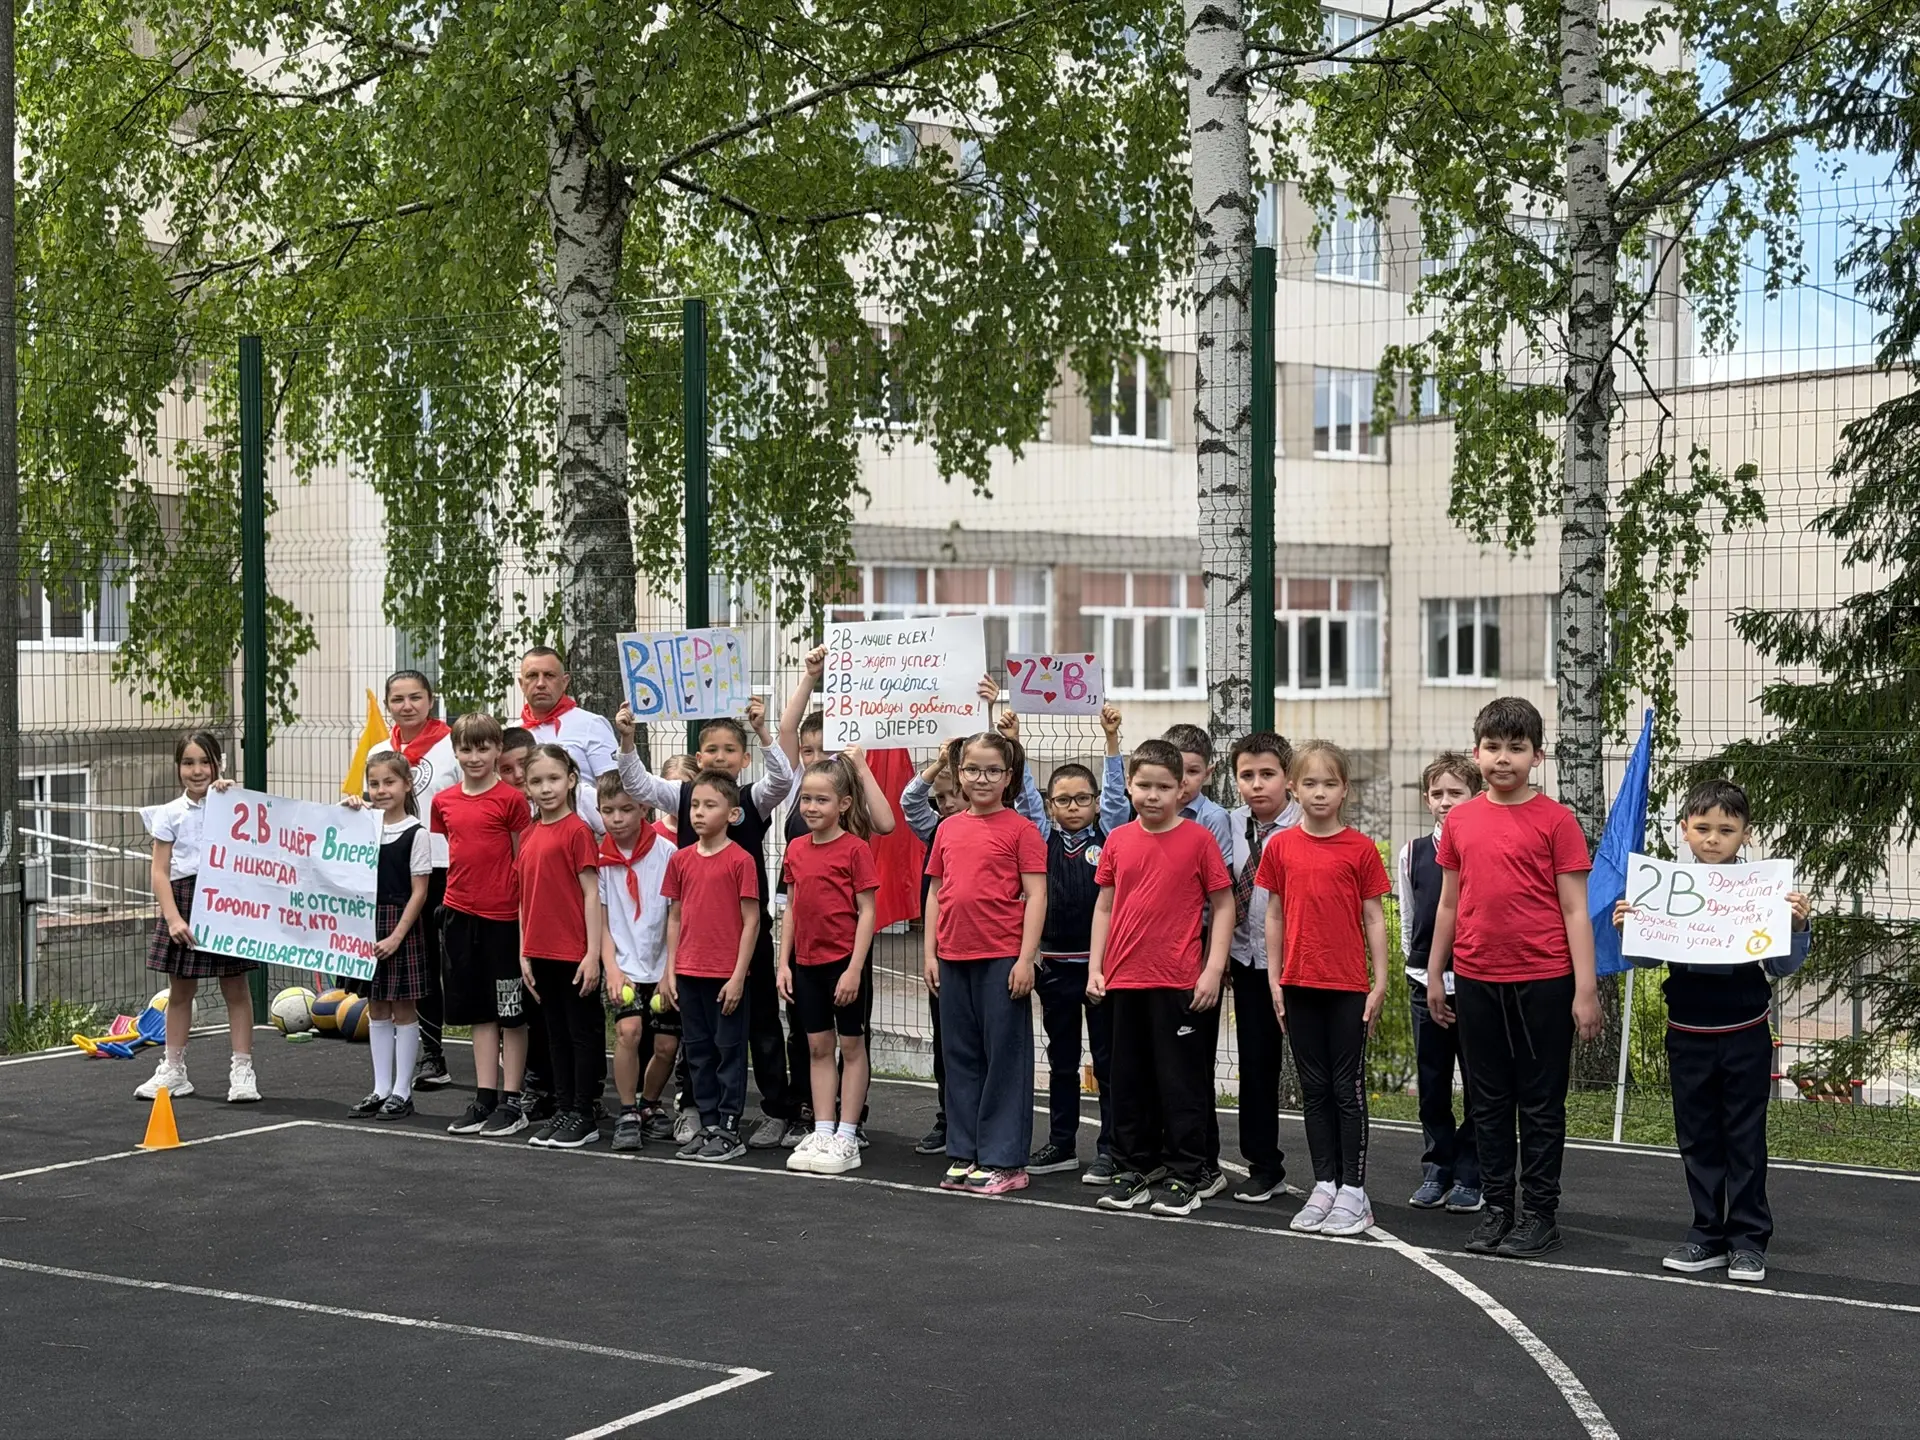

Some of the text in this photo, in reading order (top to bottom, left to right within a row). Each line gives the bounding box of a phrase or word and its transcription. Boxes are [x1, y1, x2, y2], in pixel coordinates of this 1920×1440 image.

[898, 626, 935, 645] ВСЕХ!
[901, 652, 947, 672] успех!
[880, 674, 940, 697] сдаётся
[909, 696, 981, 719] добьётся!
[838, 717, 938, 742] 2В ВПЕРЁД
[209, 844, 226, 869] И
[1632, 864, 1705, 917] 2В
[1634, 909, 1716, 933] Дружба нам
